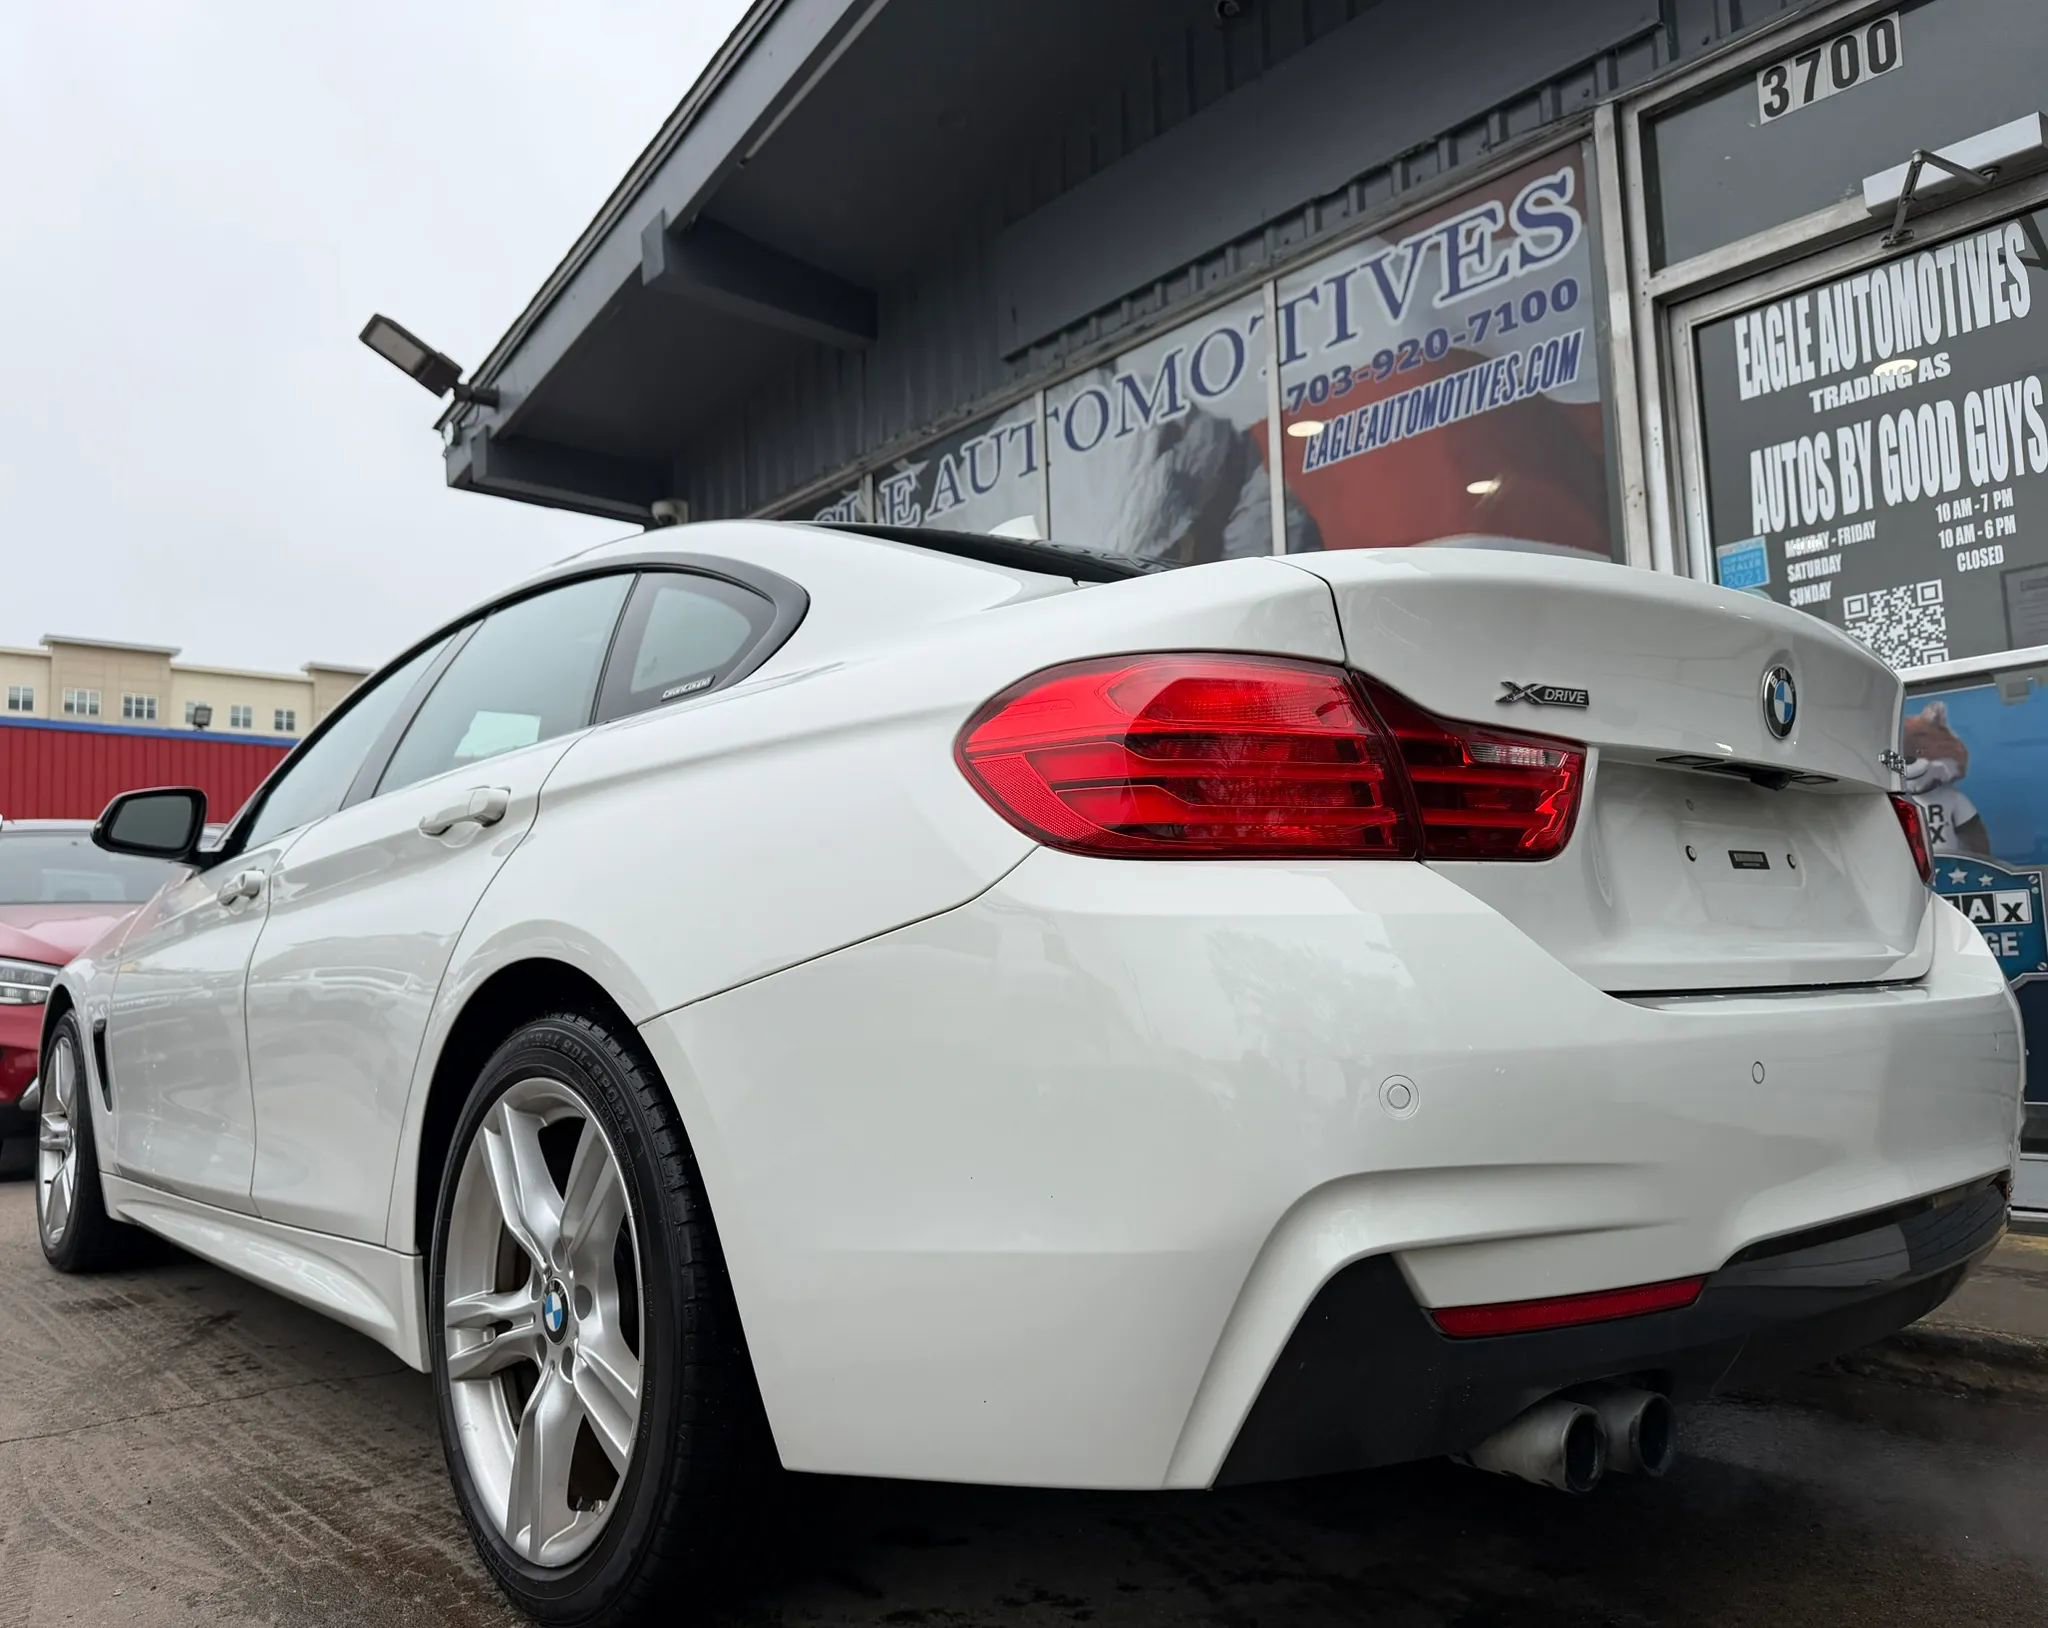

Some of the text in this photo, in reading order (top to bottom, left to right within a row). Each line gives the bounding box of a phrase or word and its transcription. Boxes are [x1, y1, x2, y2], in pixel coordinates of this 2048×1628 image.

[1761, 18, 1898, 118] 3700
[1734, 222, 2031, 401] EAGLE AUTOMOTIVES
[925, 166, 1582, 521] AUTOMOTIVES
[1286, 277, 1580, 414] 703-920-7100
[1301, 328, 1585, 473] EAGLEAUTOMOTIVES.COM
[1809, 352, 1951, 414] TRADING AS
[1750, 375, 2048, 537] AUTOS BY GOOD GUYS
[1935, 502, 1951, 523] 10
[1952, 497, 1973, 520] AM
[1980, 492, 1988, 513] 7
[1993, 487, 2014, 510] PM
[1938, 528, 1954, 549] 10
[1955, 523, 1976, 546] AM
[1984, 519, 1994, 539] 6
[1995, 514, 2016, 536] PM
[1784, 531, 1830, 558] MONDAY
[1837, 519, 1876, 546] FRIDAY
[1786, 553, 1842, 583] SATURDAY
[1956, 544, 2005, 572] CLOSED
[1789, 580, 1832, 607] SUNDAY
